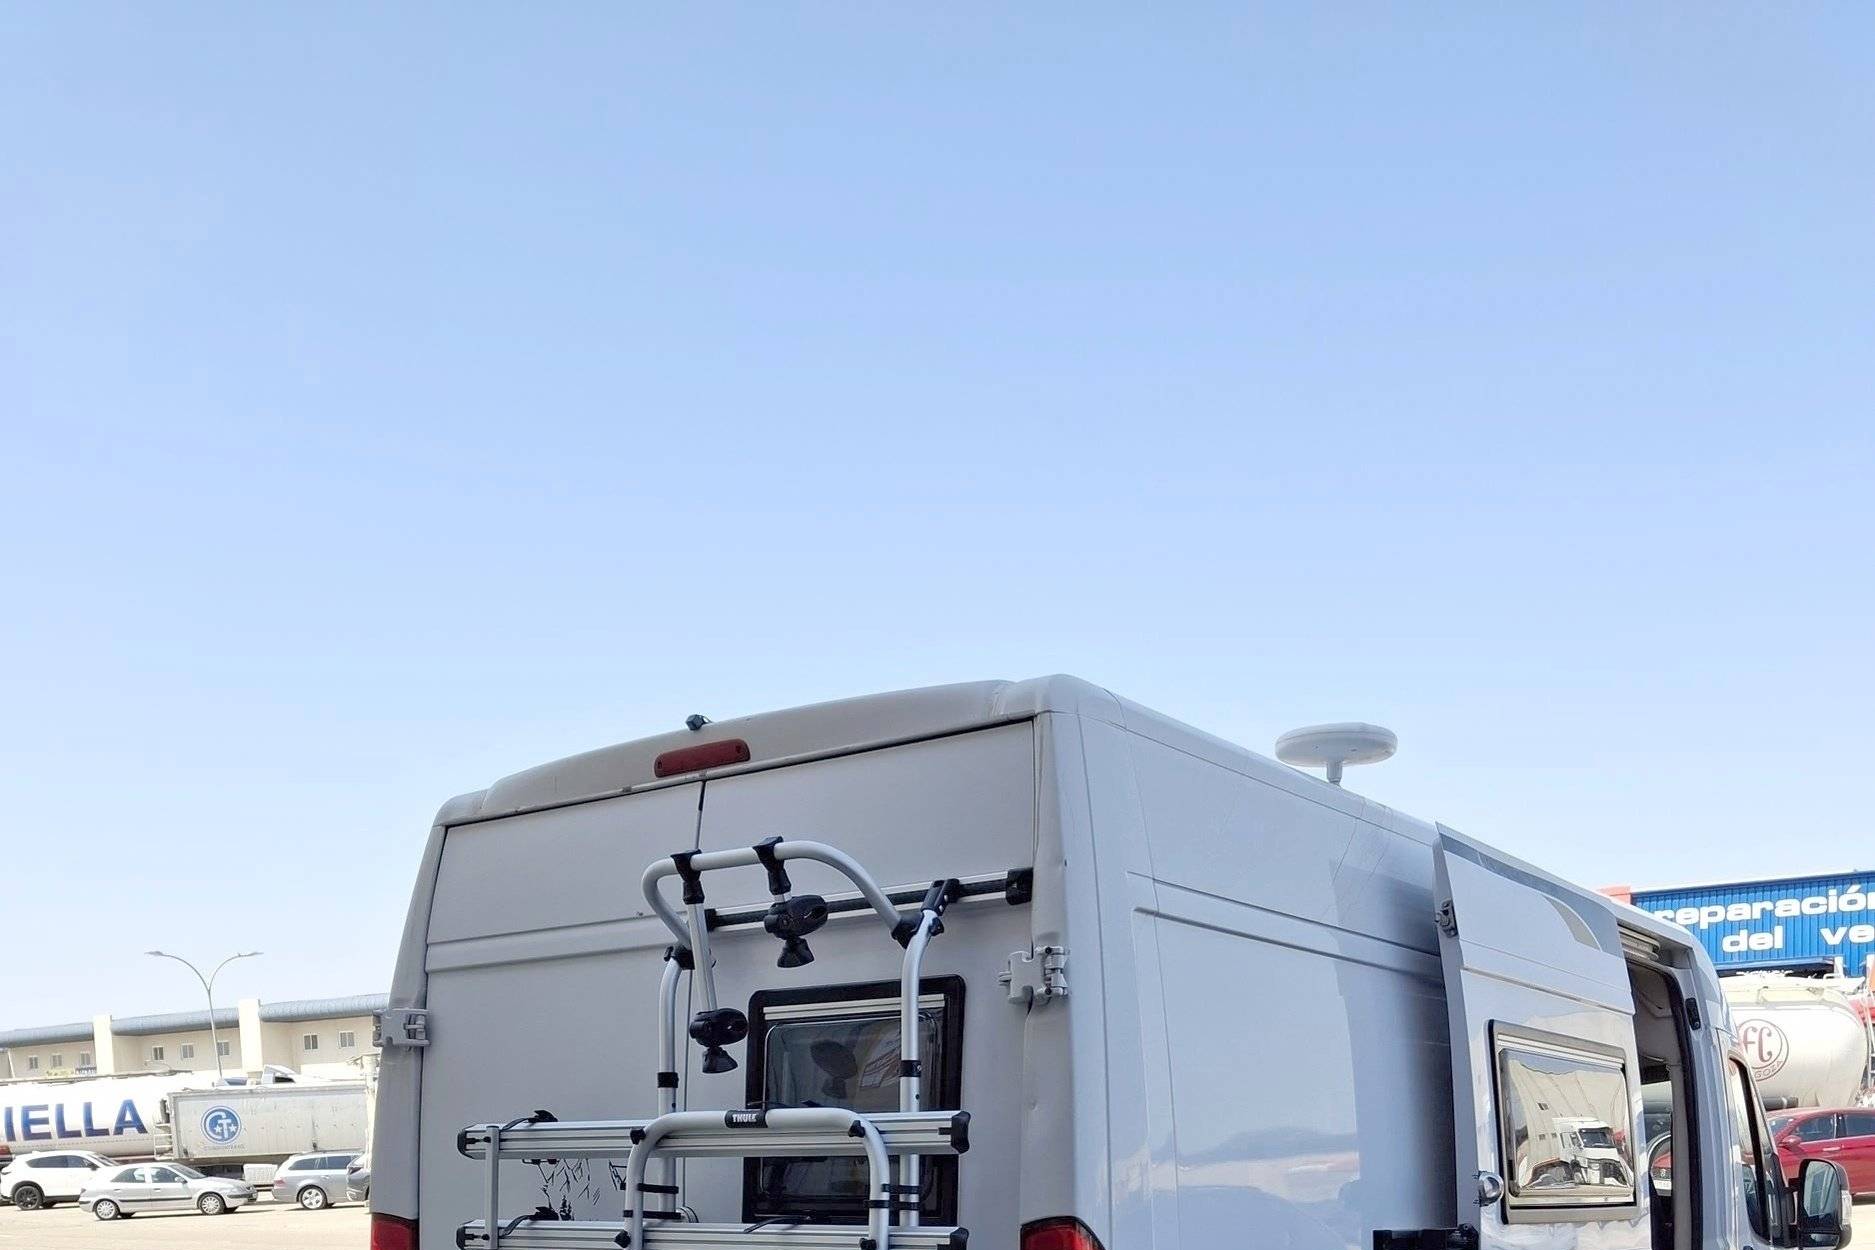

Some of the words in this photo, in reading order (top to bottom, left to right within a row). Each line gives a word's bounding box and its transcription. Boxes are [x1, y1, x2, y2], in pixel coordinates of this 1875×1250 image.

[1653, 884, 1875, 929] reparació
[1721, 925, 1783, 952] del
[4, 1099, 149, 1142] IELLA
[731, 1113, 757, 1123] THULE
